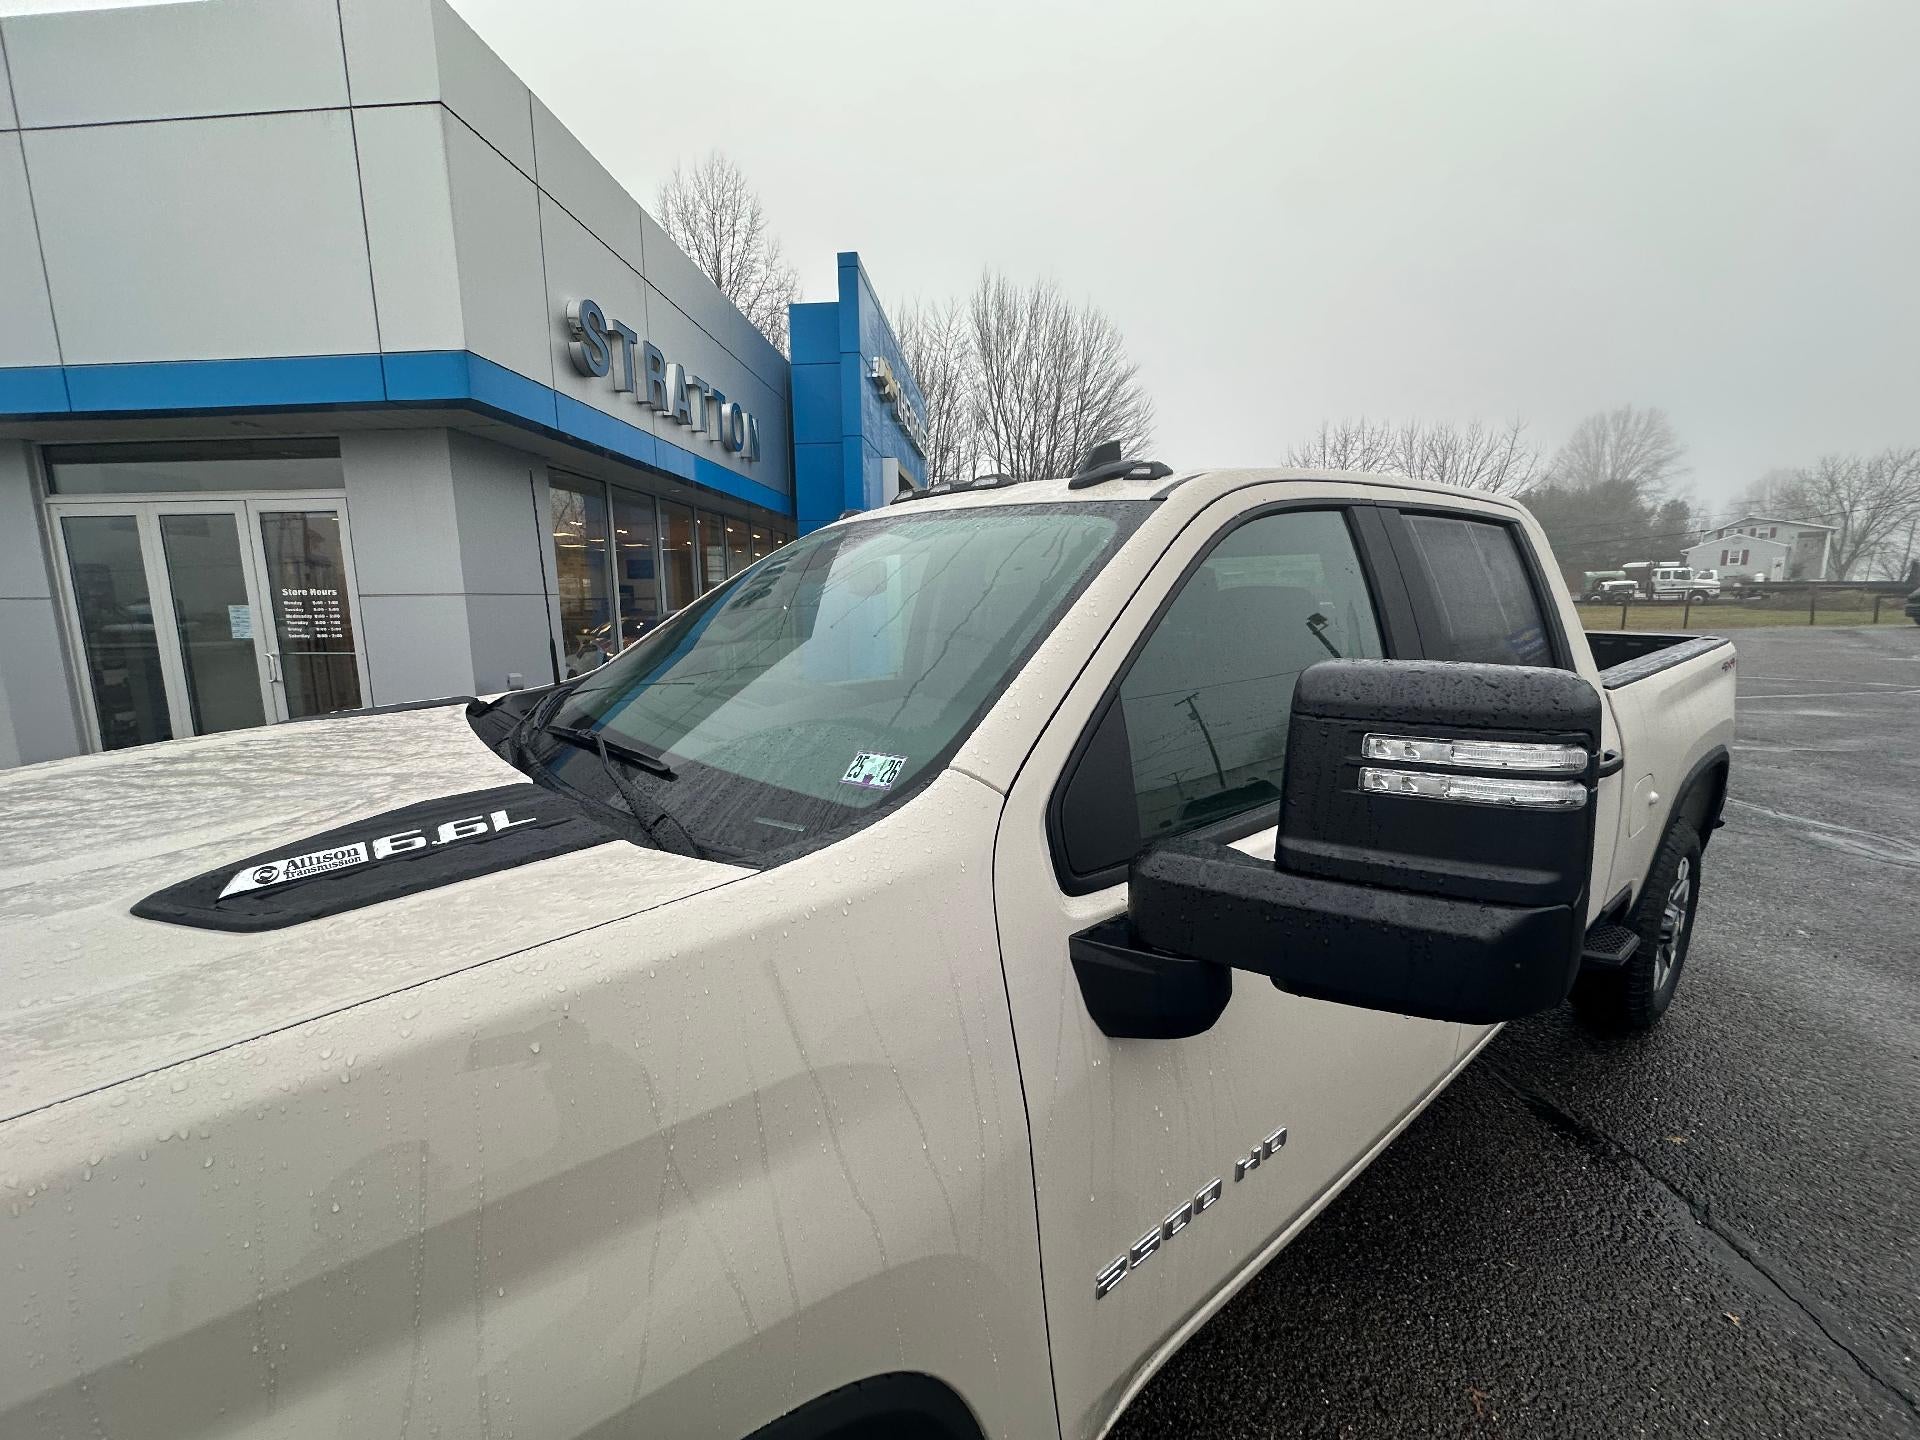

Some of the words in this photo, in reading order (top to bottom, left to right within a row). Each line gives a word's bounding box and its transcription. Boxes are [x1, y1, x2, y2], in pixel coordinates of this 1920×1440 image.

[566, 298, 760, 462] STRATTON
[282, 588, 308, 596] Store
[309, 588, 338, 596] Hours
[847, 754, 871, 779] 25
[879, 759, 903, 784] 26
[372, 809, 537, 860] 6.6L
[283, 856, 362, 880] Transmission
[285, 847, 361, 872] Allison
[1095, 1176, 1222, 1300] 2500
[1234, 1125, 1288, 1183] HD
